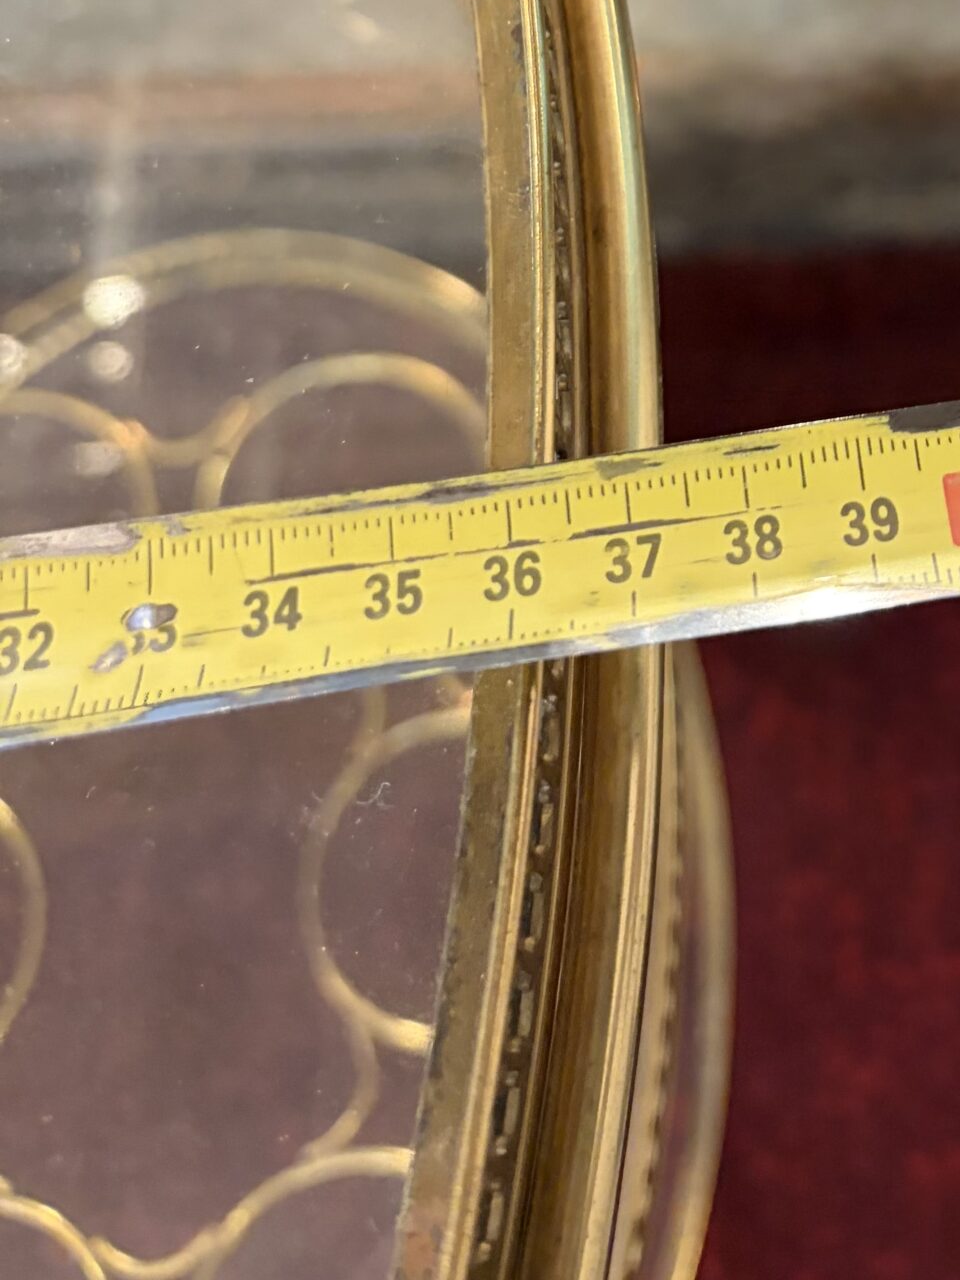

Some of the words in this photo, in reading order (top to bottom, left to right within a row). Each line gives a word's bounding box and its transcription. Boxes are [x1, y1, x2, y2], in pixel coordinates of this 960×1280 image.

[0, 621, 54, 676] 32
[241, 586, 302, 638] 34
[363, 570, 424, 619] 35
[483, 550, 542, 602] 36
[604, 533, 665, 584] 37
[722, 515, 782, 565] 38
[840, 497, 899, 547] 39
